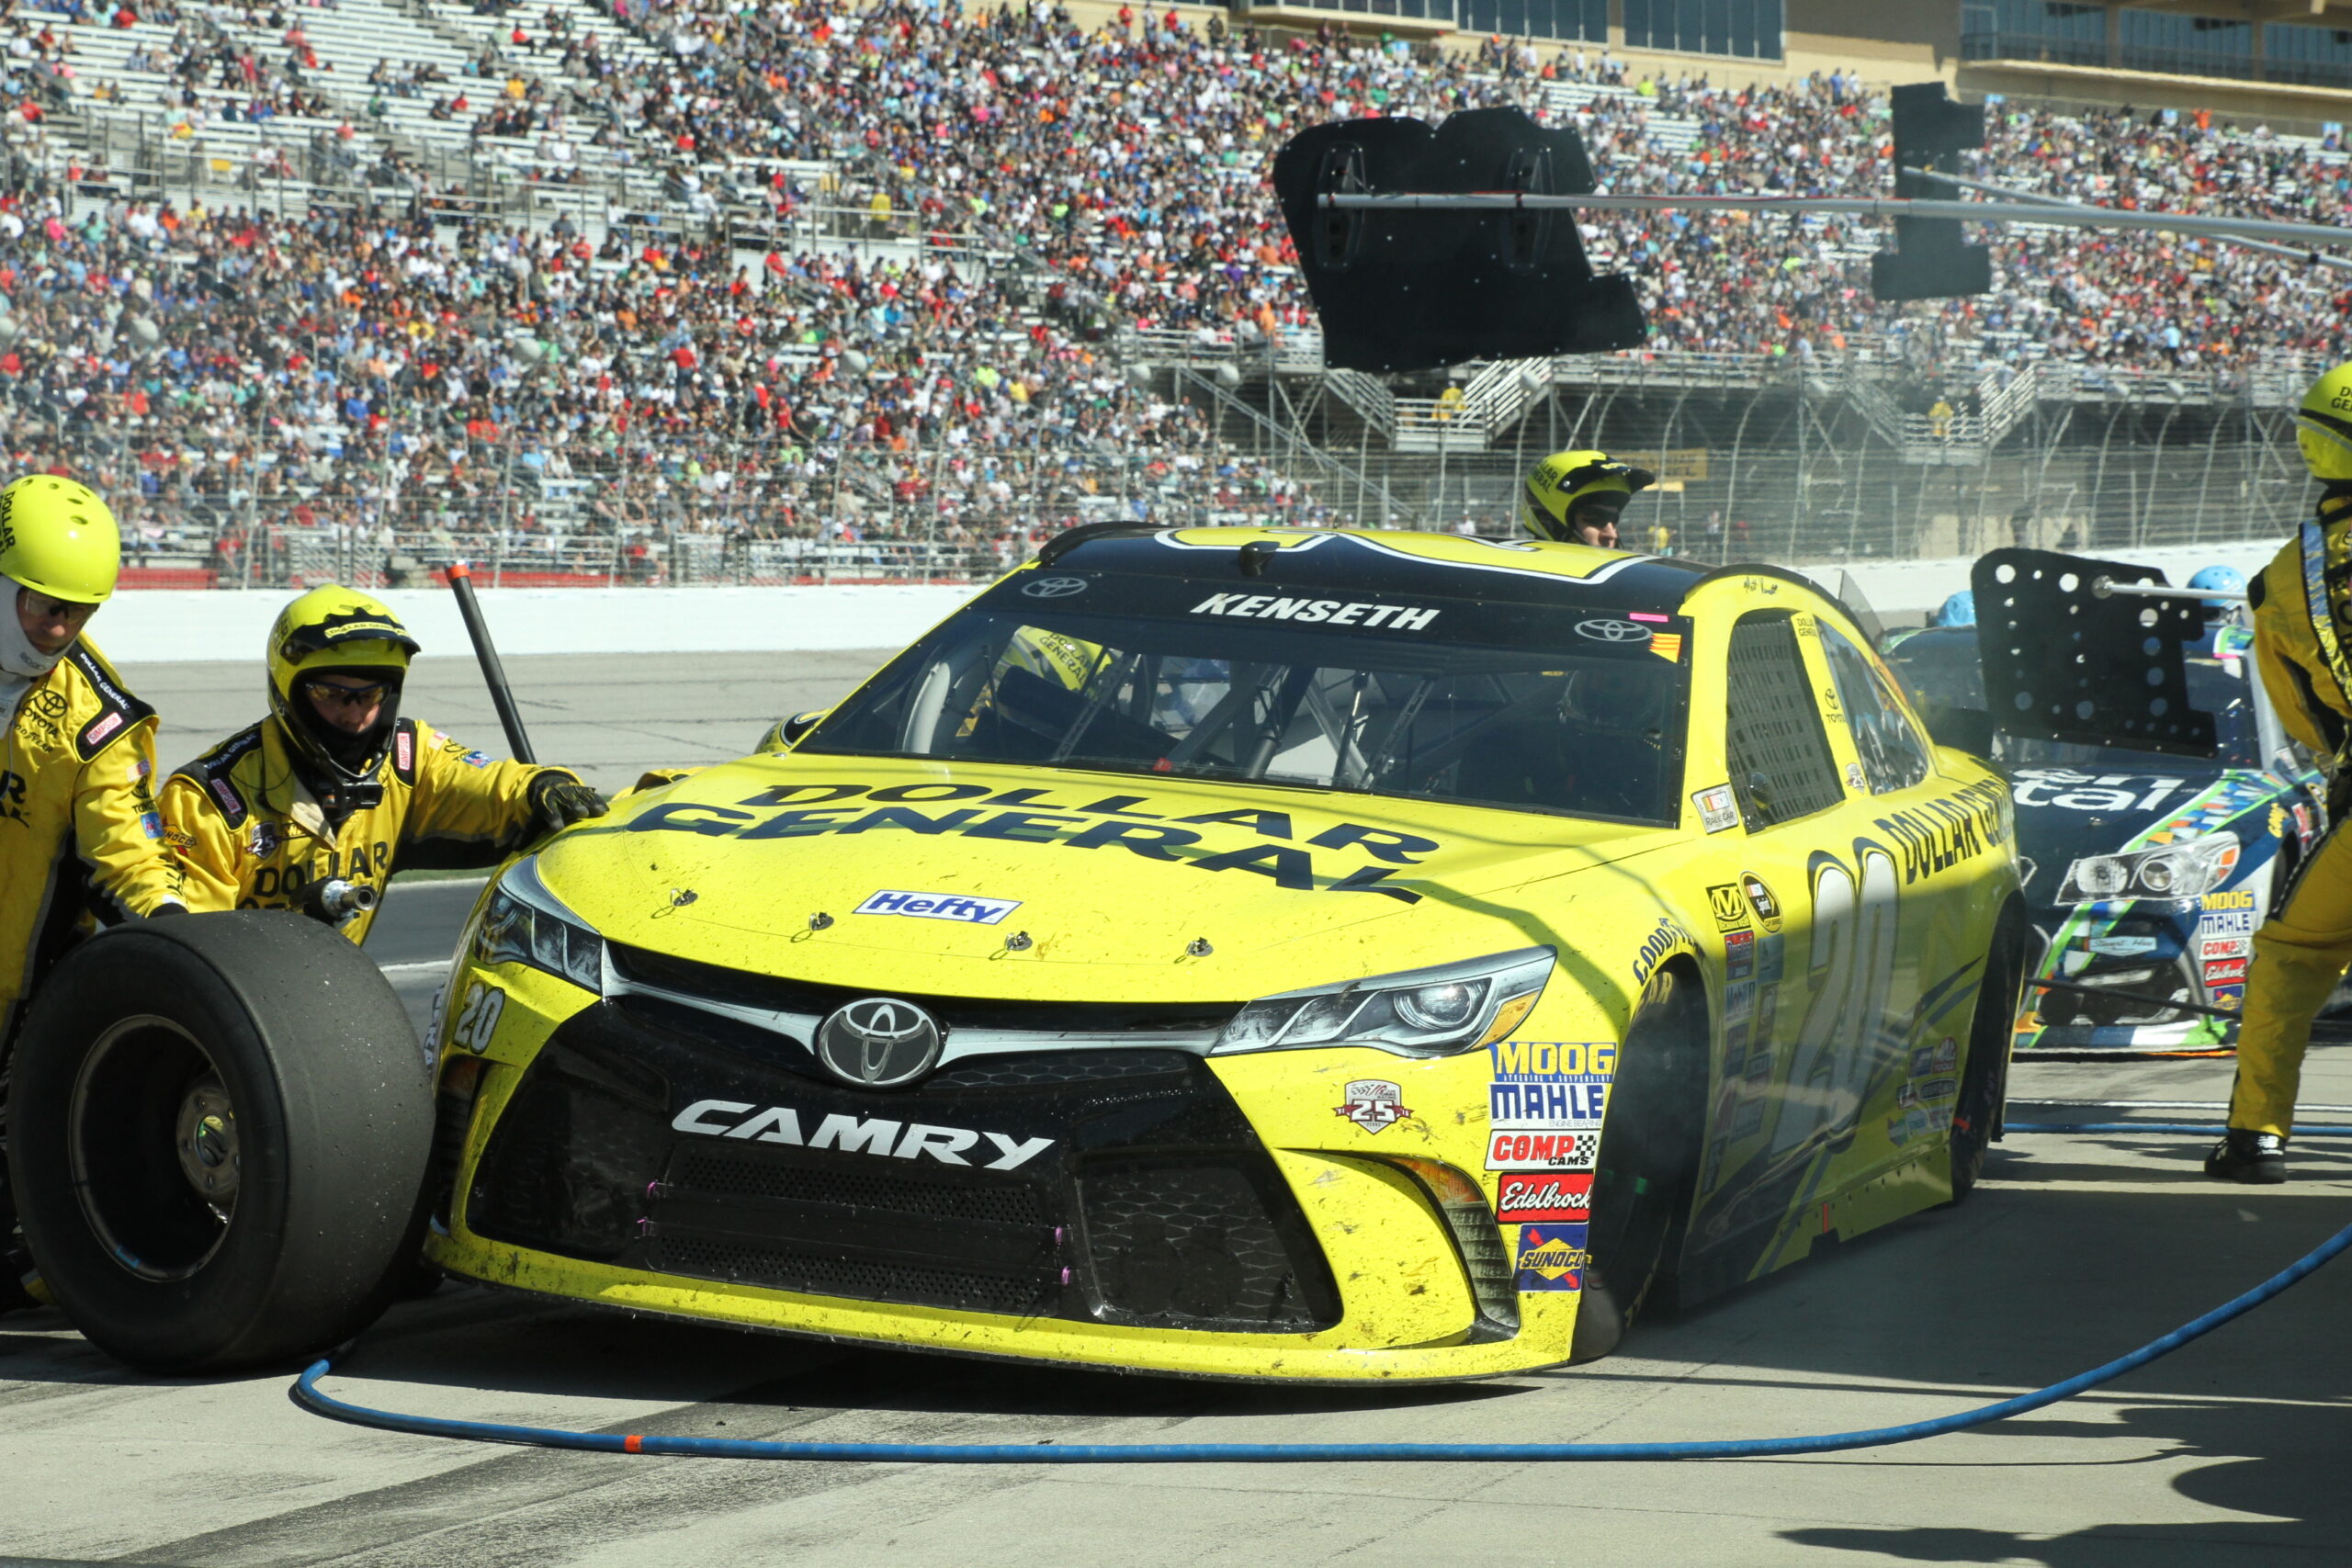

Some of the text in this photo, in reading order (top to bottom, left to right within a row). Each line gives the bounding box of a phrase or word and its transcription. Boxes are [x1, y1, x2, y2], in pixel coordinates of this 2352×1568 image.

[1191, 592, 1442, 631] KENSETH
[18, 705, 59, 738] OYOTA
[735, 784, 1439, 864] DOLLAR
[628, 801, 1427, 904] GENERAL
[1872, 798, 1982, 885] DOLLAR
[866, 893, 1005, 923] Hefty
[2201, 890, 2254, 910] MOOG
[2202, 913, 2250, 933] MAHLE
[2203, 940, 2238, 955] COMP
[454, 980, 505, 1055] 20
[1497, 1043, 1614, 1075] MOOG
[1351, 1099, 1396, 1122] 25
[1490, 1084, 1604, 1119] MAHLE
[672, 1099, 1056, 1171] CAMRY
[1493, 1135, 1576, 1161] COMP
[1548, 1156, 1591, 1166] CAMS
[1500, 1181, 1592, 1212] Edelbrock
